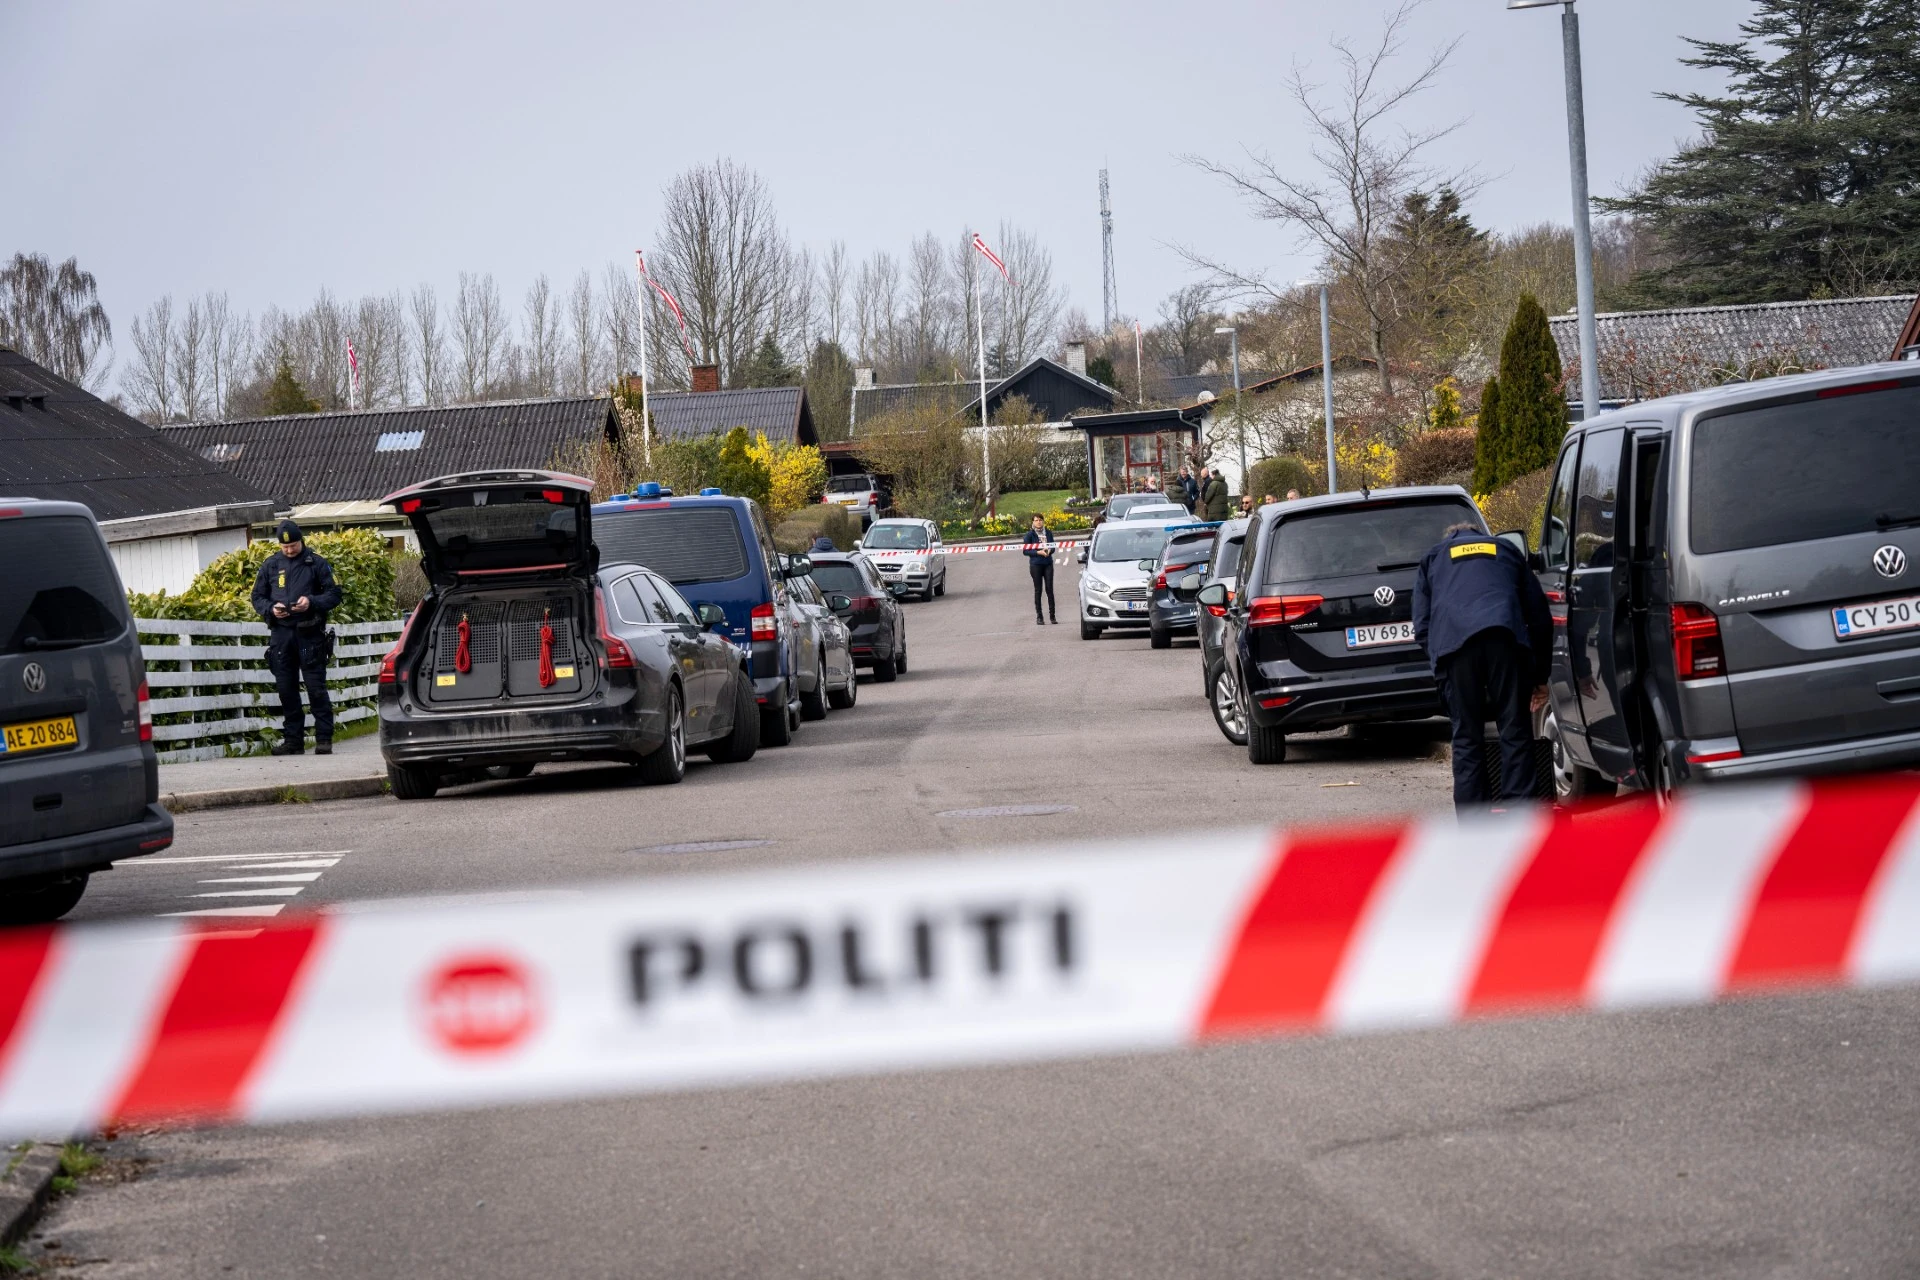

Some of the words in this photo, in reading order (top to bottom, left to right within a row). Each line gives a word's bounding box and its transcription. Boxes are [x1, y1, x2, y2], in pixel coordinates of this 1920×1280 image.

[1462, 545, 1485, 553] NKC
[1718, 589, 1791, 607] CARAVELLE
[1851, 607, 1877, 628] CY
[1884, 603, 1910, 624] 50
[1357, 627, 1377, 642] BV
[1381, 625, 1398, 640] 69
[7, 726, 26, 749] AE
[27, 725, 46, 746] 20
[48, 720, 75, 743] 884
[624, 902, 1080, 1014] POLITI
